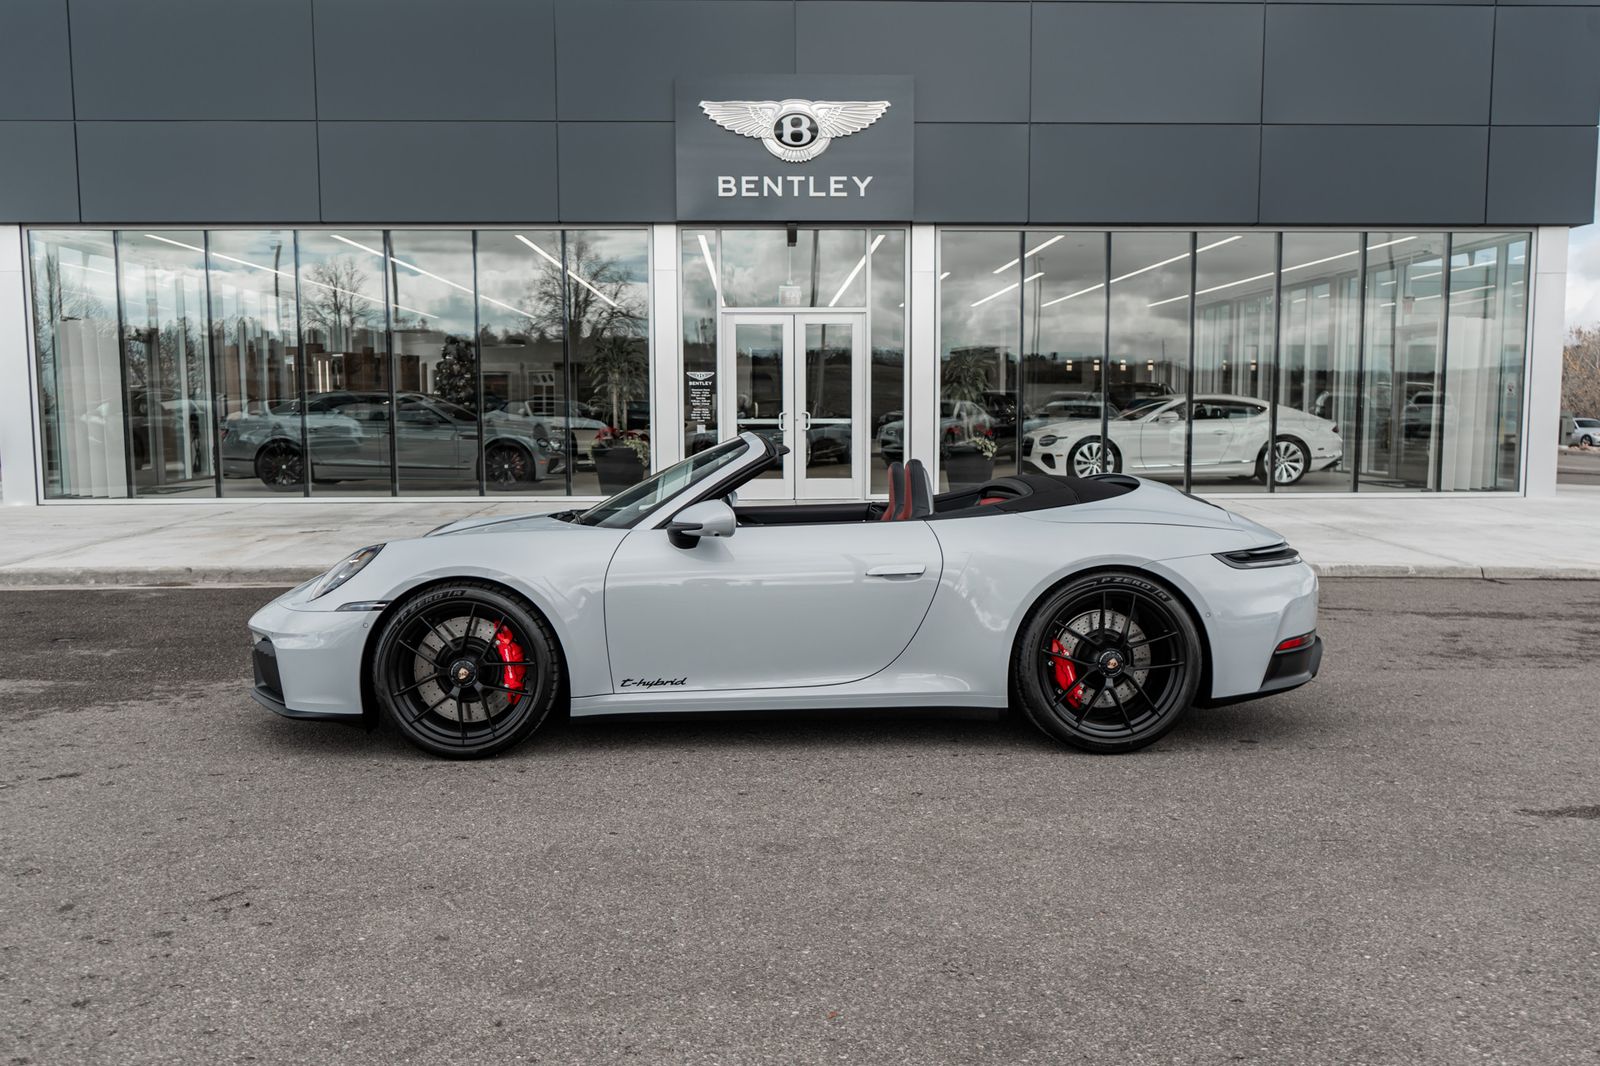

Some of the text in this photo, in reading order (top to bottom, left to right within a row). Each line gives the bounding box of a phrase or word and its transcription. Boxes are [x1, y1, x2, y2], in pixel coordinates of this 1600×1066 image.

[781, 115, 811, 145] B
[717, 176, 874, 197] BENTLEY
[1112, 577, 1151, 589] ZERO
